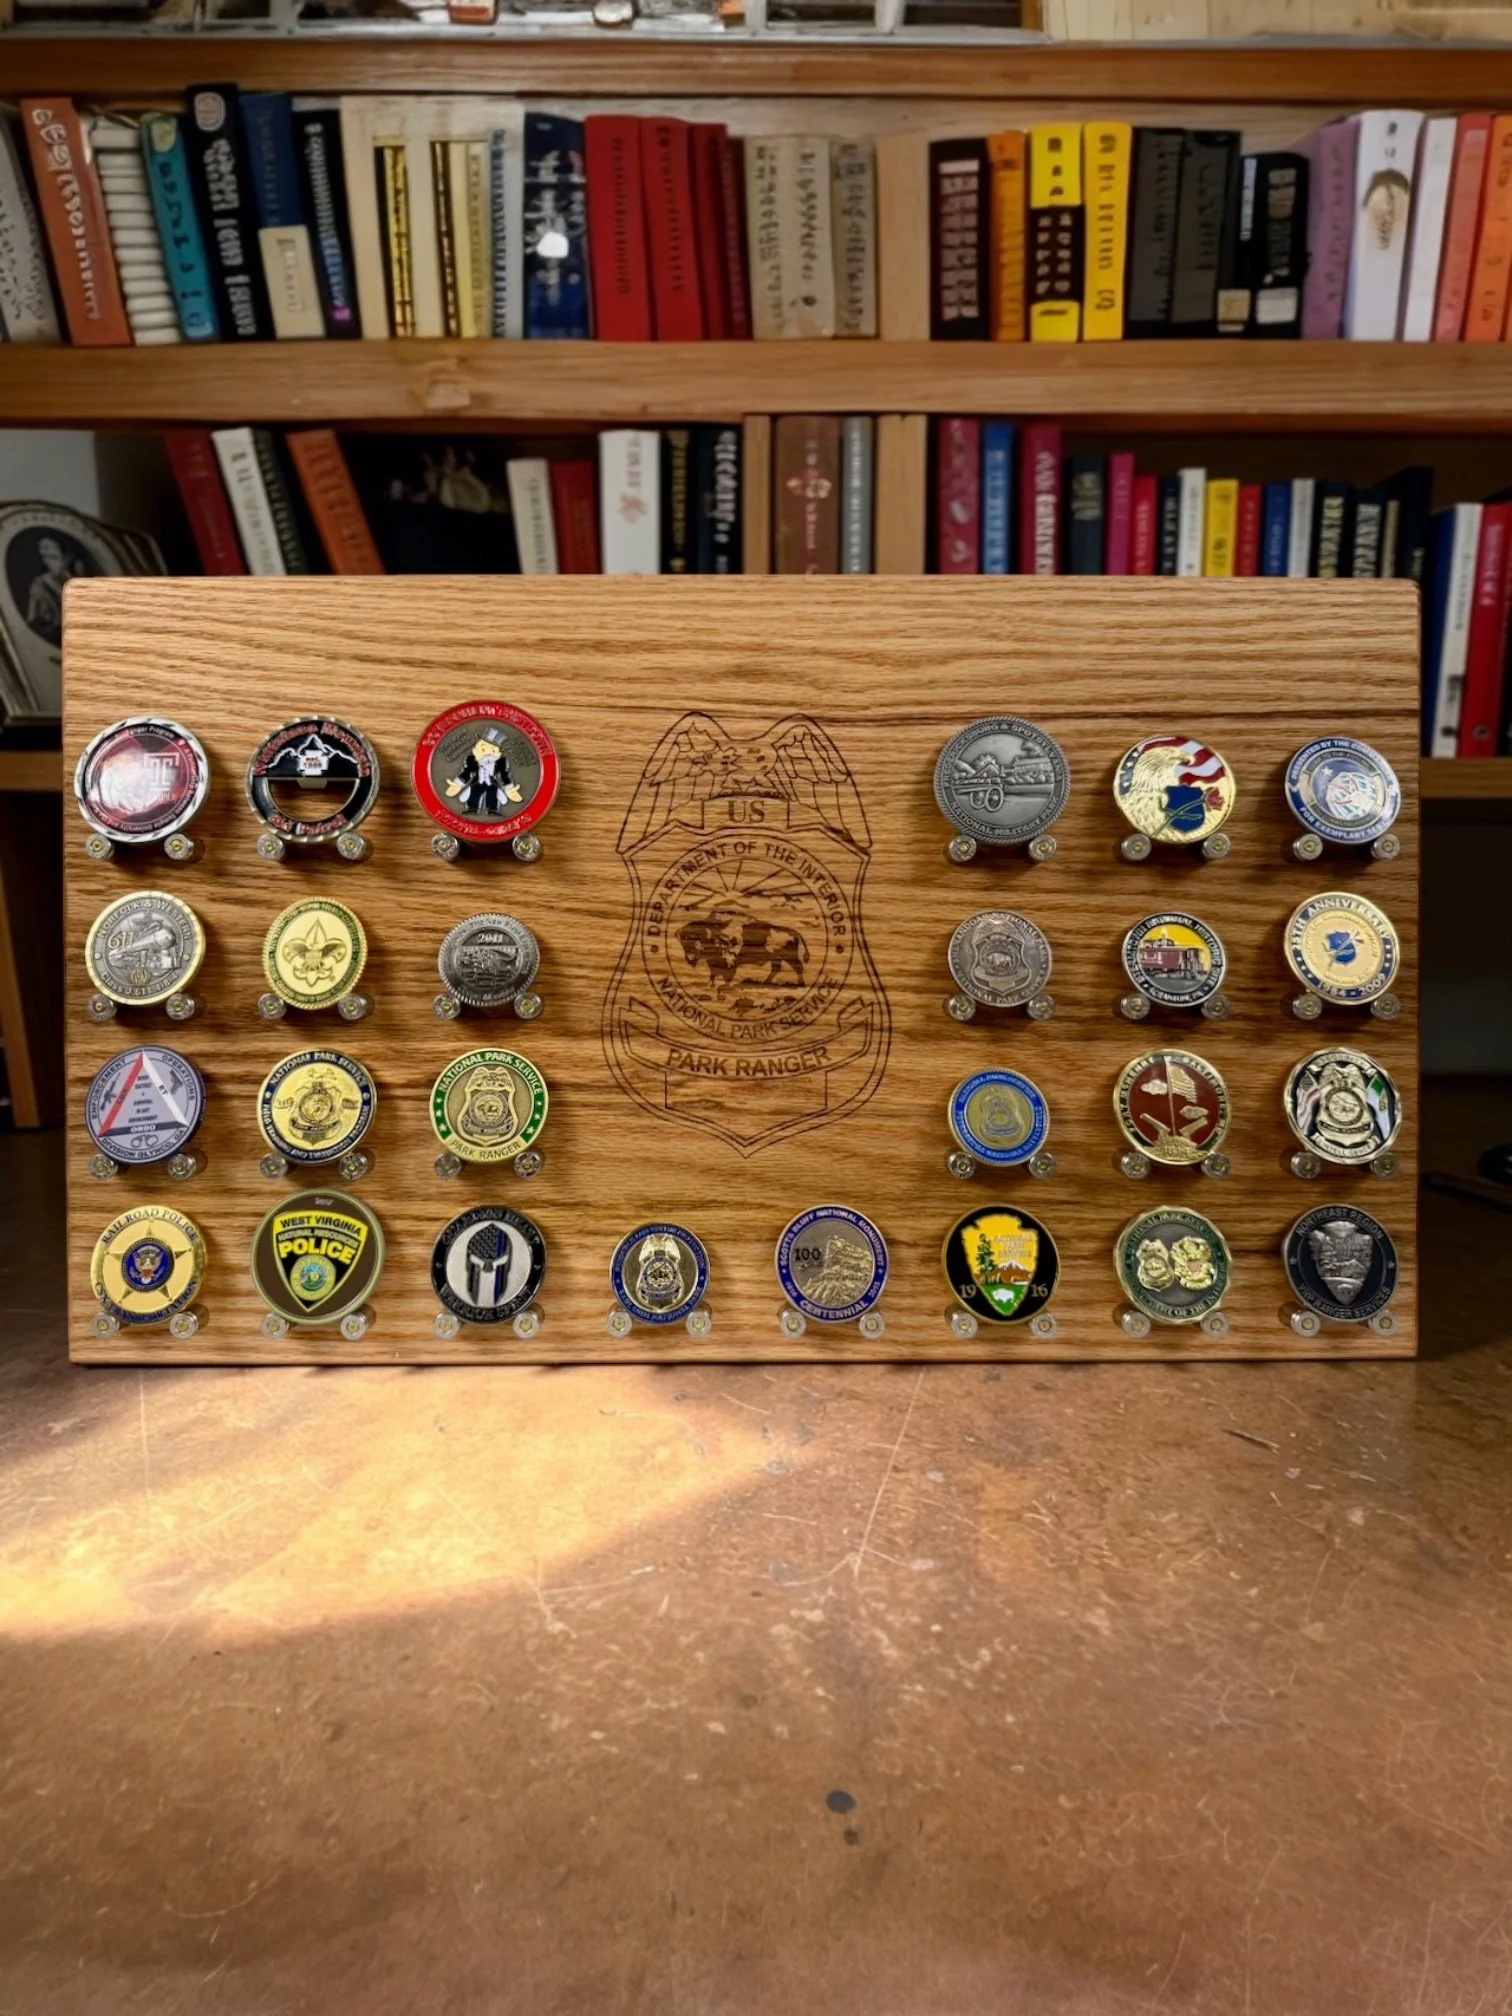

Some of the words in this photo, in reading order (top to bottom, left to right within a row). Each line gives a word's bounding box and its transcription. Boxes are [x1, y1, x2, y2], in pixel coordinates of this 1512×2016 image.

[726, 800, 766, 824] US
[646, 840, 738, 938] DEPARTMENT
[733, 840, 758, 854] OF
[763, 842, 798, 866] THE
[798, 858, 847, 937] INTERIOR
[1307, 899, 1391, 939] ANNIVERSARY
[108, 932, 134, 949] 611
[656, 976, 725, 1038] NATIONAL
[730, 1020, 775, 1040] PARK
[778, 976, 840, 1034] SERVICE
[271, 1053, 311, 1084] NATIONAL
[438, 1054, 483, 1092] NATIONAL
[485, 1052, 513, 1064] PARK
[513, 1059, 543, 1094] SERVICE
[666, 1048, 730, 1077] PARK
[735, 1045, 831, 1077] RANGER
[162, 1055, 195, 1101] OPERATIONS
[102, 1137, 136, 1158] DIVISION
[450, 1140, 476, 1157] PARK
[480, 1142, 521, 1159] RANGER
[101, 1208, 159, 1244] RAILROAD
[161, 1210, 199, 1241] POLICE
[280, 1216, 312, 1228] WEST
[315, 1215, 361, 1237] VIRGINIA
[816, 1209, 857, 1222] NATIONAL
[1296, 1208, 1347, 1237] NORTHEAST
[1349, 1211, 1384, 1239] REGION
[278, 1238, 355, 1265] POLICE
[794, 1247, 821, 1261] 100
[960, 1284, 977, 1298] 19
[1030, 1284, 1048, 1297] 16
[800, 1300, 869, 1319] CENTENNIAL
